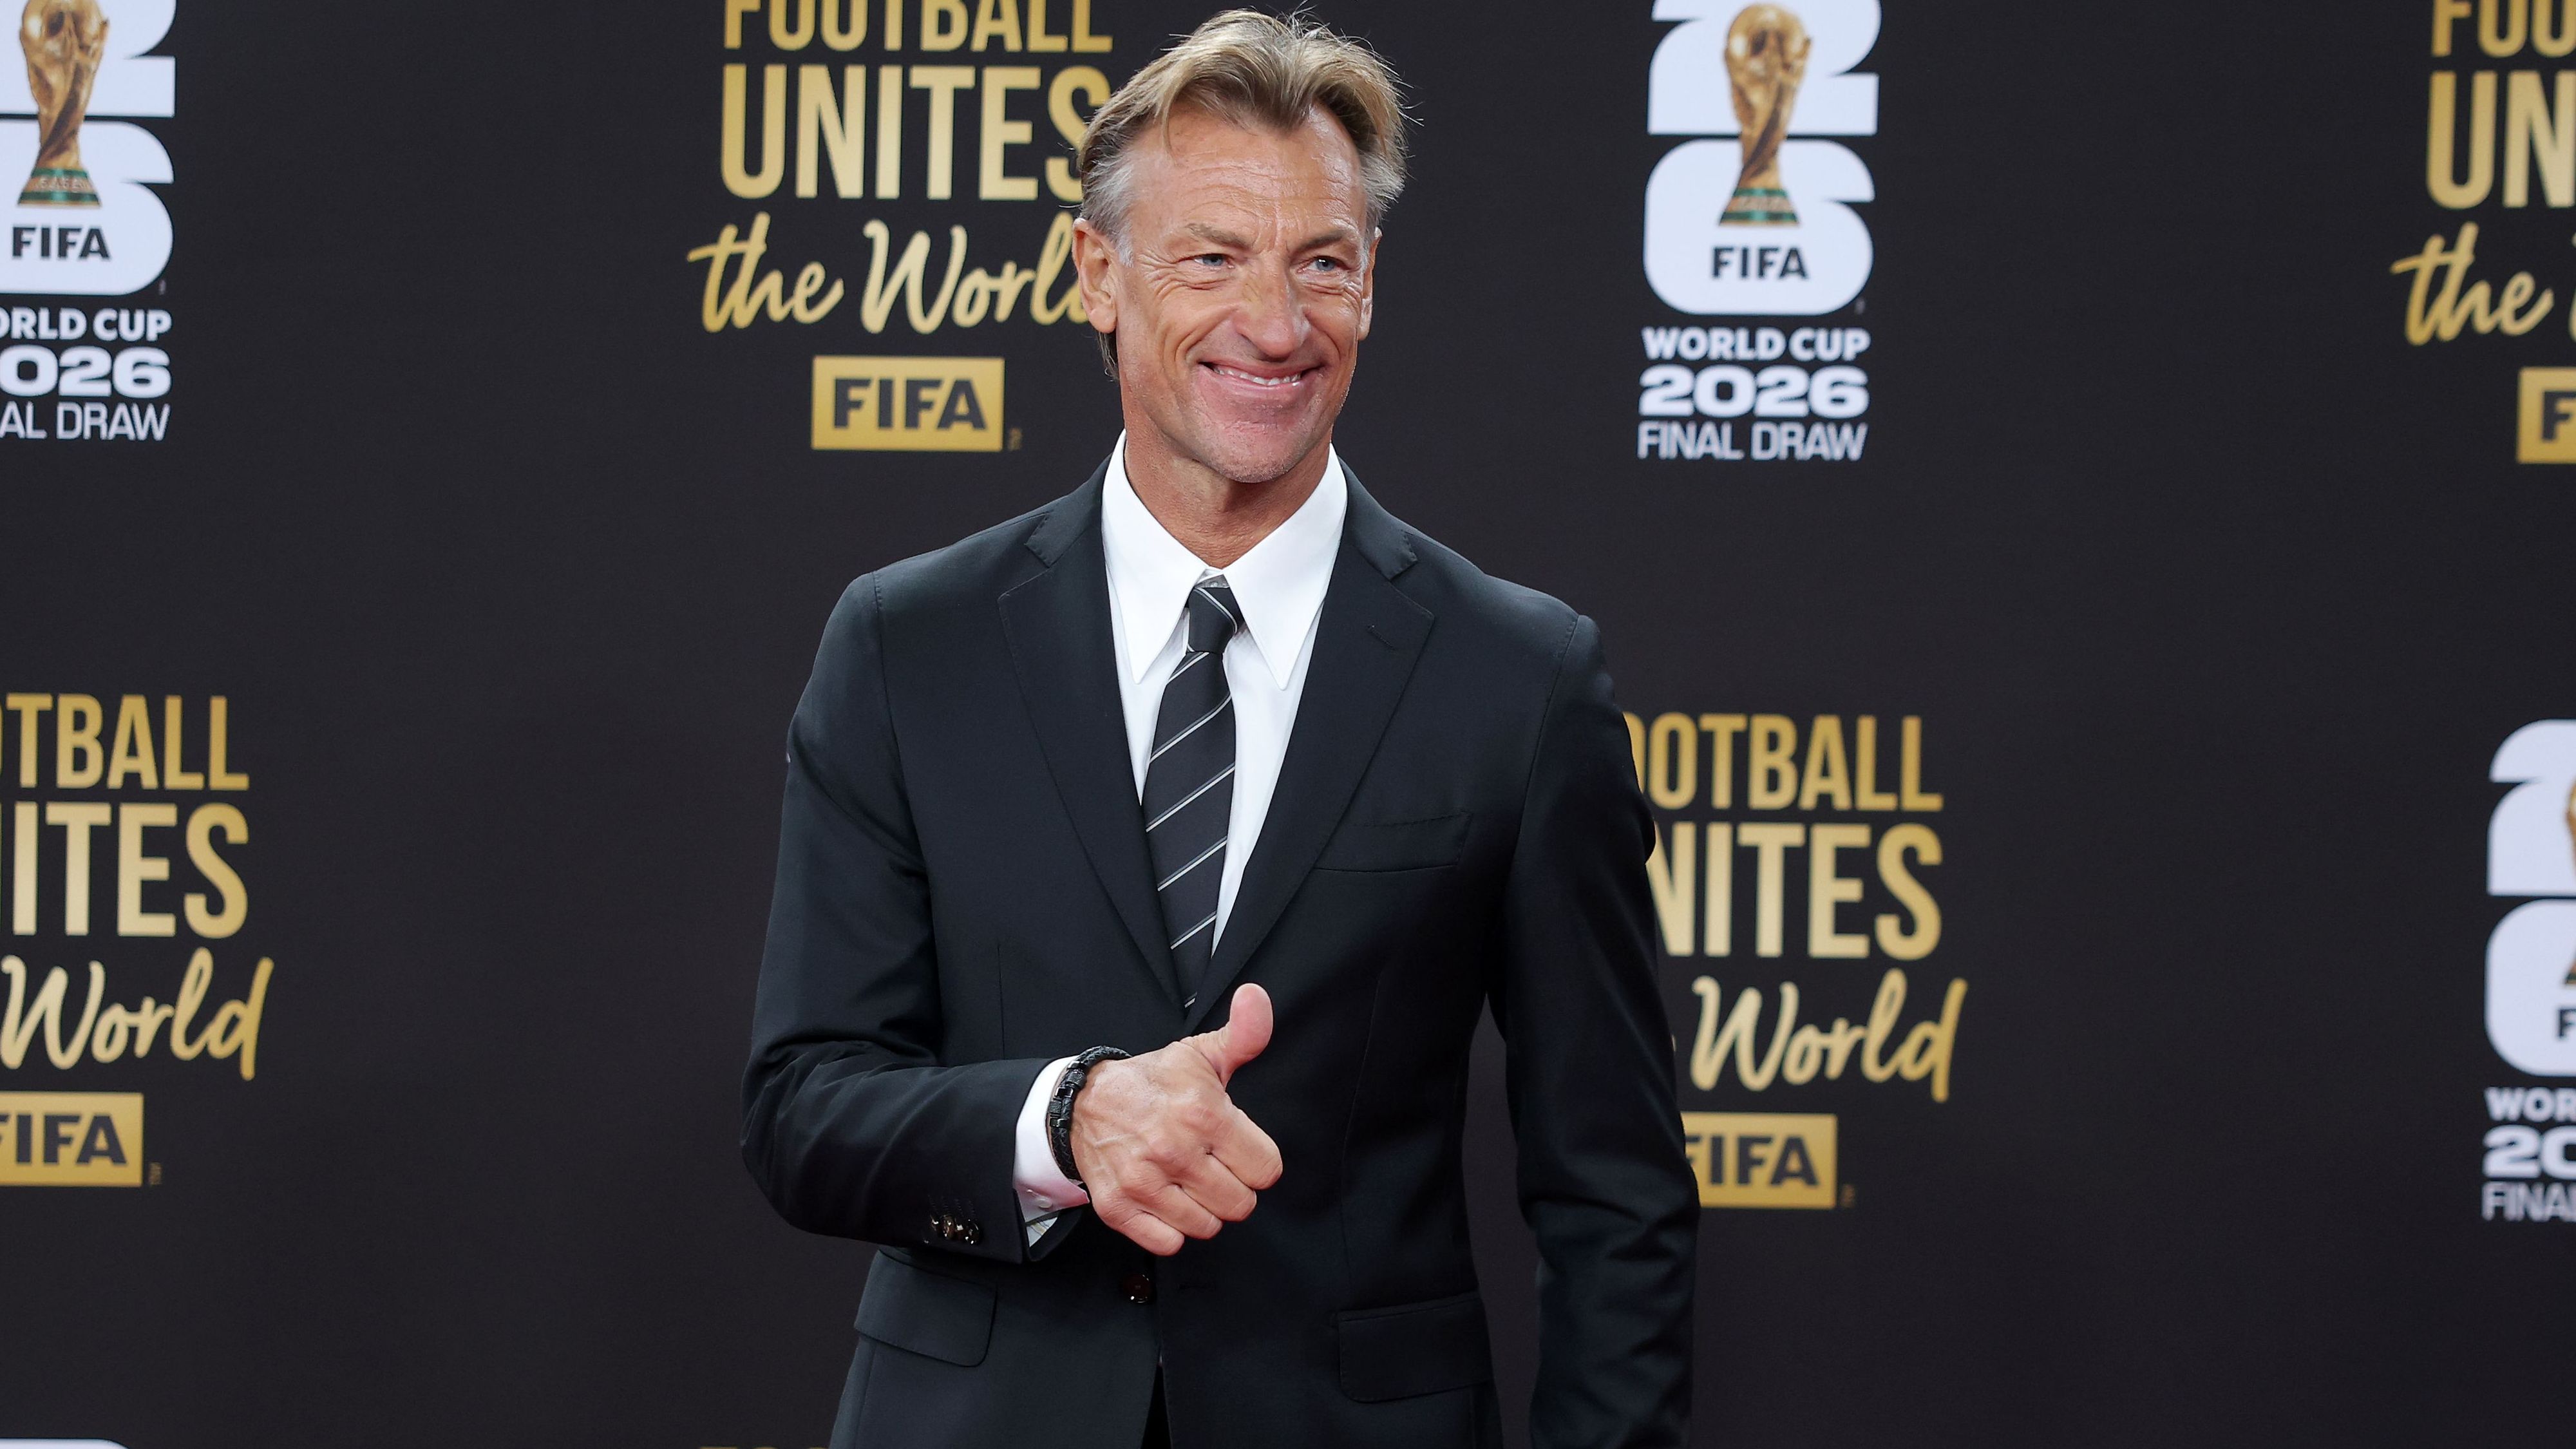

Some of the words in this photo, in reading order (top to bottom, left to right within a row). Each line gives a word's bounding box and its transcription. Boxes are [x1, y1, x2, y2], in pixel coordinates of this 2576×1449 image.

[721, 63, 1111, 202] UNITES
[12, 226, 110, 260] FIFA
[687, 212, 844, 332] the
[1712, 247, 1807, 279] FIFA
[2391, 222, 2554, 345] the
[93, 308, 172, 341] CUP
[1642, 327, 1786, 361] WORLD
[1789, 327, 1870, 361] CUP
[56, 402, 170, 441] DRAW
[833, 378, 987, 430] FIFA
[1638, 364, 1869, 419] 2026
[1638, 421, 1744, 460] FINAL
[1751, 422, 1868, 461] DRAW
[0, 693, 249, 790] TBALL
[1623, 712, 1944, 811] OTBALL
[0, 801, 249, 938] ITES
[1645, 820, 1942, 960] NITES
[0, 947, 274, 1080] World
[1690, 969, 1967, 1102] World
[0, 1114, 127, 1164] IFA
